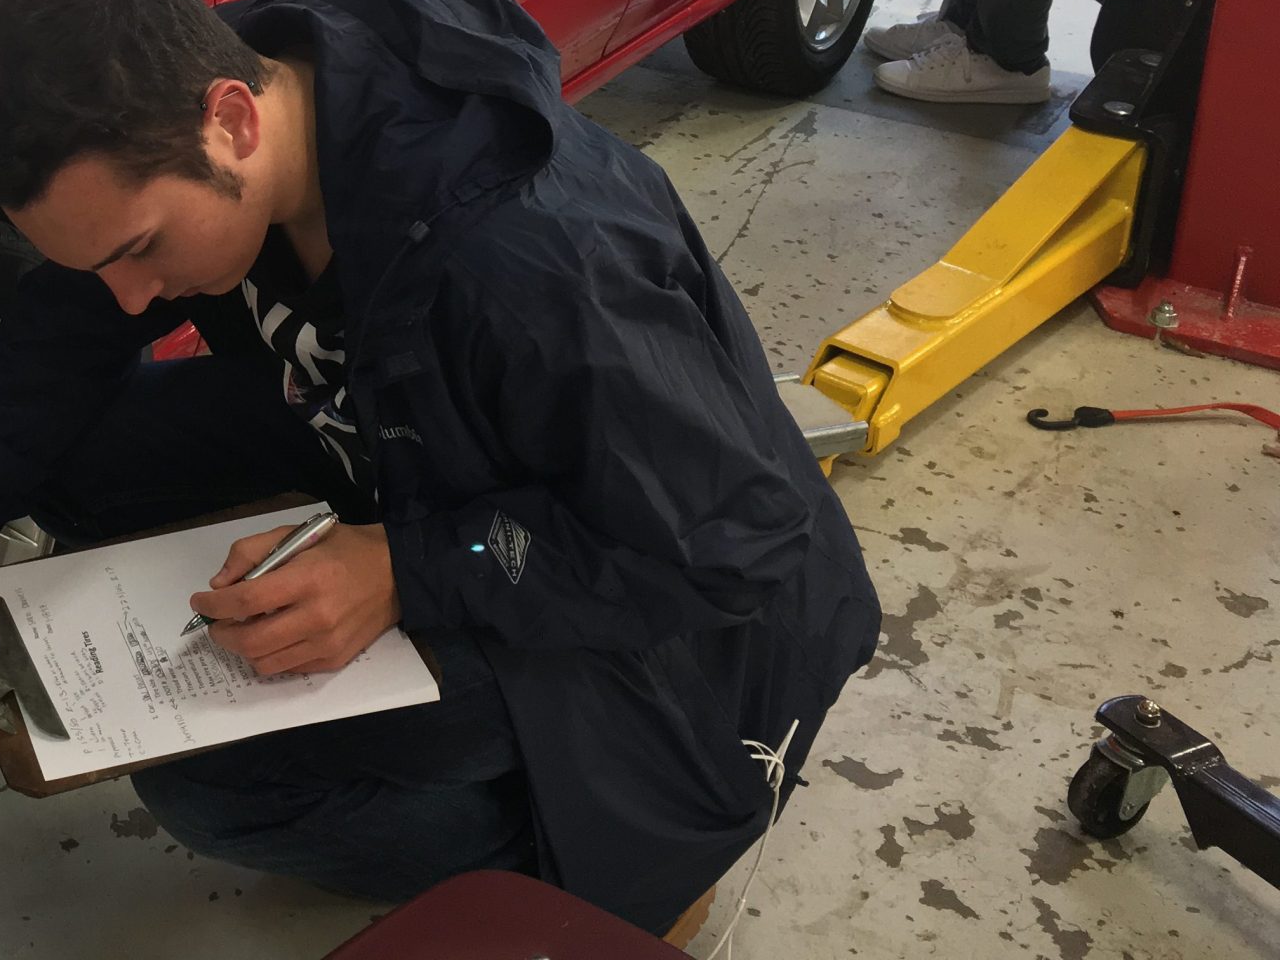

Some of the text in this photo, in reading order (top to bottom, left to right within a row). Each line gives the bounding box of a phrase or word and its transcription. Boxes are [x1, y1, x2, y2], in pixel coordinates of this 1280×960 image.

[379, 424, 424, 446] lumbia
[79, 630, 93, 647] Tires
[85, 646, 105, 673] Reading
[180, 671, 194, 691] Traction
[186, 658, 206, 689] Temperature
